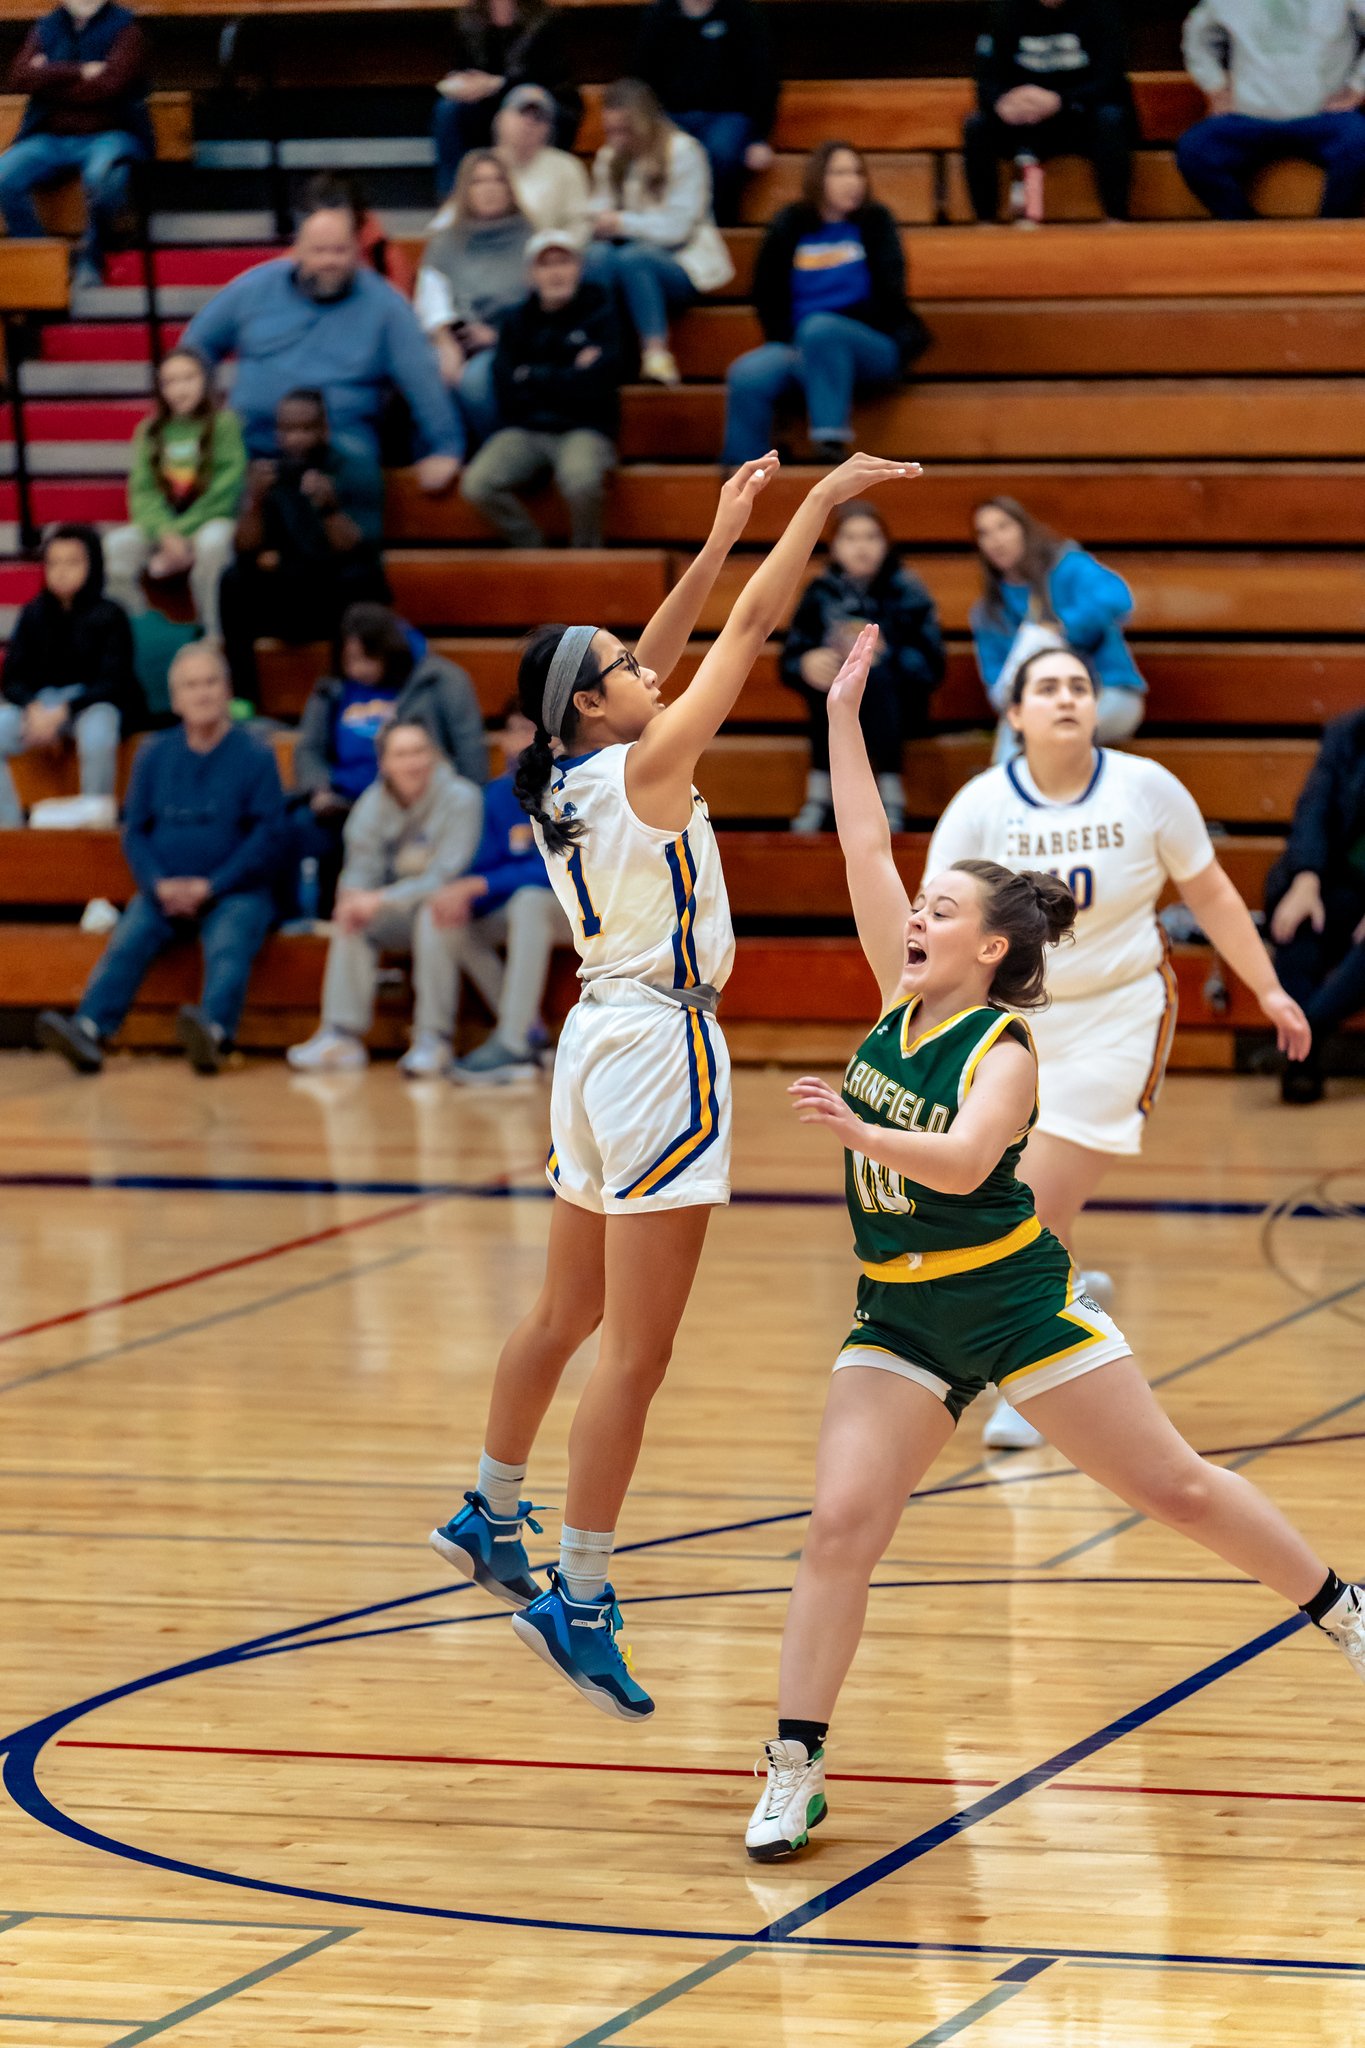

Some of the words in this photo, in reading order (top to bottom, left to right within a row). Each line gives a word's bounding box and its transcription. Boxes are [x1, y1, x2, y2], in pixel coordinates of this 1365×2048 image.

[566, 842, 604, 940] 1
[1048, 866, 1096, 912] 0
[843, 1053, 951, 1134] LAINFIELD
